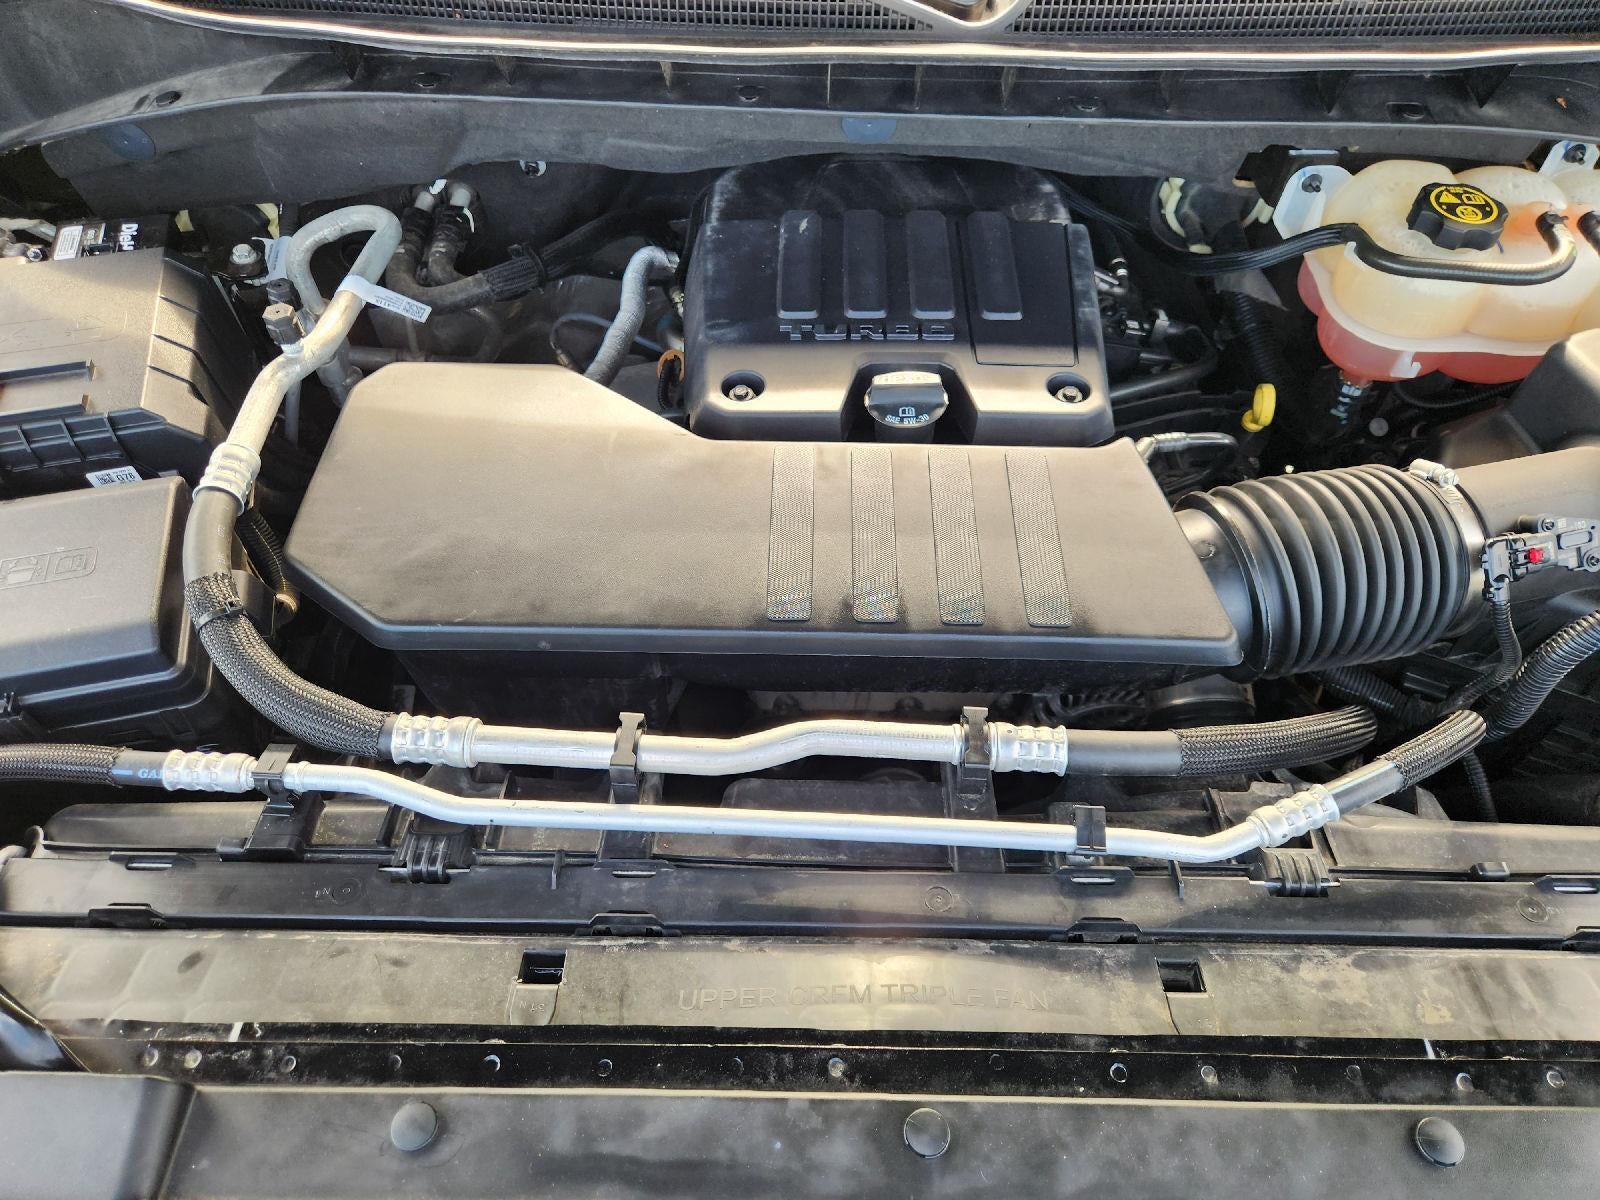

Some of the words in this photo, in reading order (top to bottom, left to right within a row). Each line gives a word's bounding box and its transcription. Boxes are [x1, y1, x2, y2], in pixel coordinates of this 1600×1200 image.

[779, 323, 955, 341] TURBO
[885, 414, 901, 424] SAE
[903, 413, 930, 425] 5W-30
[138, 767, 164, 779] GA
[679, 985, 778, 1011] UPPER
[880, 983, 985, 1008] TRIPLE
[992, 985, 1050, 1011] FAN
